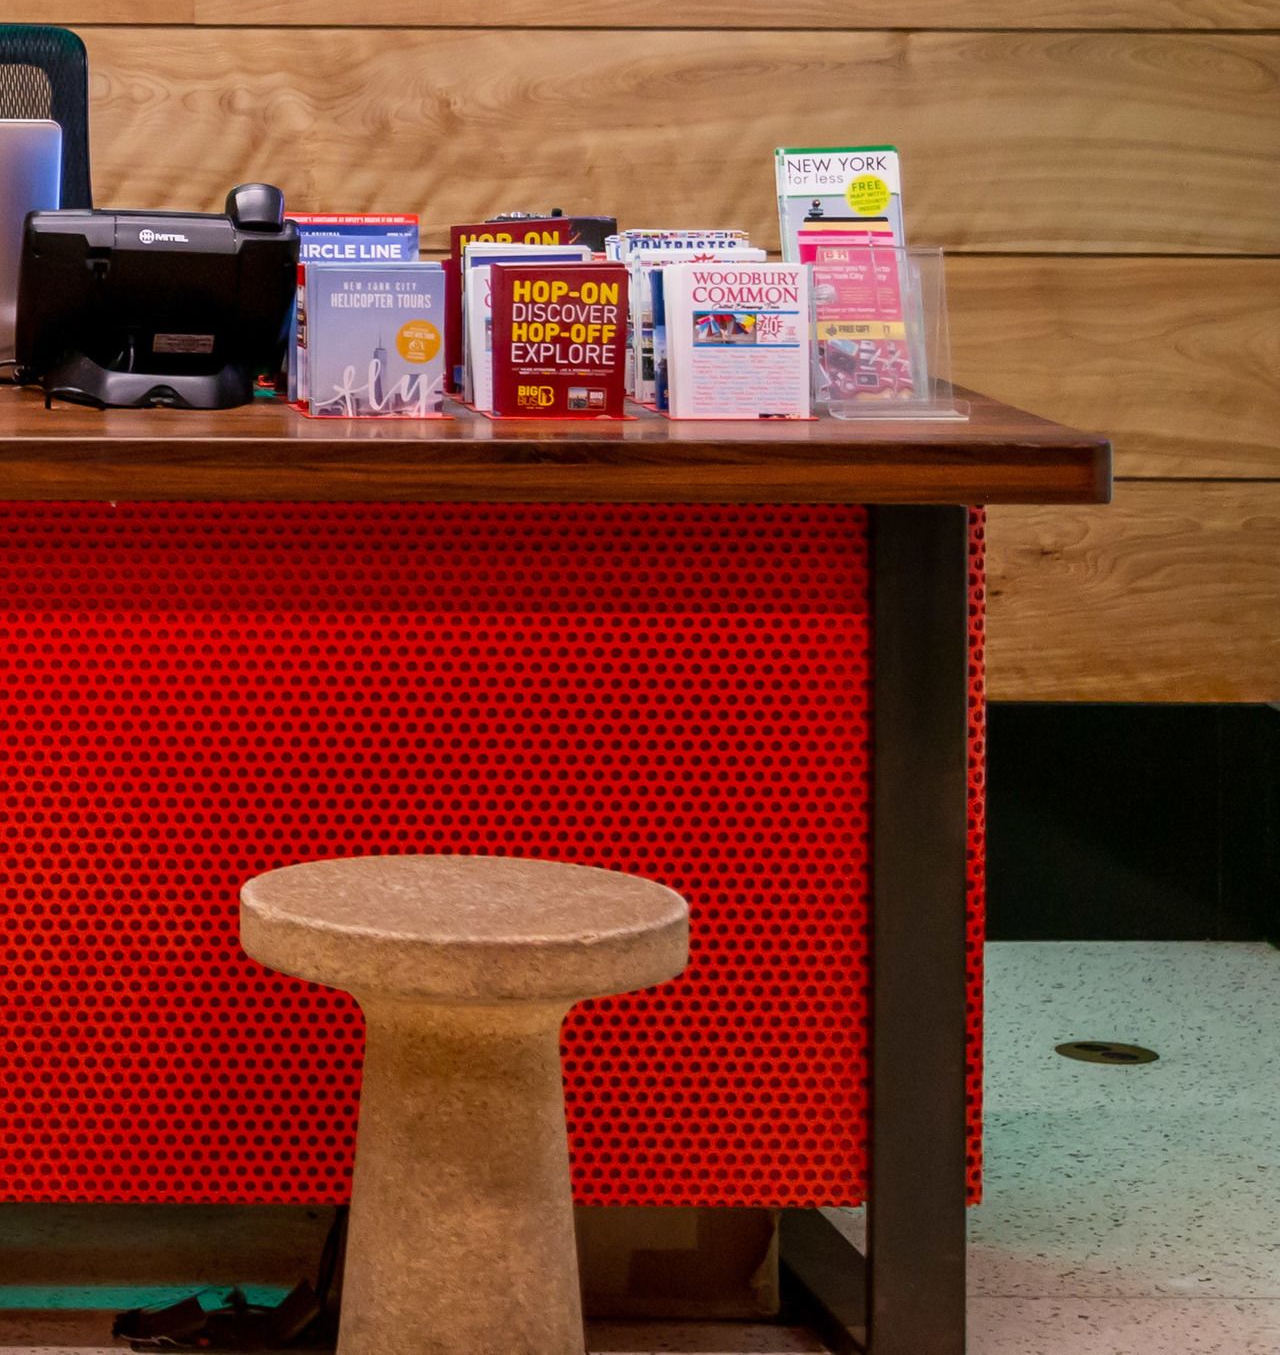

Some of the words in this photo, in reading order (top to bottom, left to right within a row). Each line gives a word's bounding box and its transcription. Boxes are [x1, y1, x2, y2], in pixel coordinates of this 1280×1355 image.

[787, 158, 831, 173] NEW
[838, 156, 887, 172] YORK
[788, 173, 809, 185] for
[815, 173, 844, 184] less
[851, 180, 881, 192] FREE
[154, 233, 189, 244] MITEL
[299, 244, 356, 259] IRCLE
[360, 244, 402, 259] LINE
[343, 282, 362, 291] NEW
[368, 282, 390, 291] YORK
[395, 282, 417, 291] CITY
[692, 272, 799, 285] WOODBURY
[330, 292, 394, 309] HELICOPTER
[397, 293, 432, 309] TOURS
[513, 280, 619, 305] HOP-ON
[692, 287, 799, 304] COMMON
[512, 303, 617, 324] DISCOVER
[512, 322, 617, 344] HOP-OFF
[511, 343, 615, 365] EXPLORE
[315, 358, 444, 417] fly
[517, 385, 538, 396] BIG
[517, 396, 538, 406] BUS
